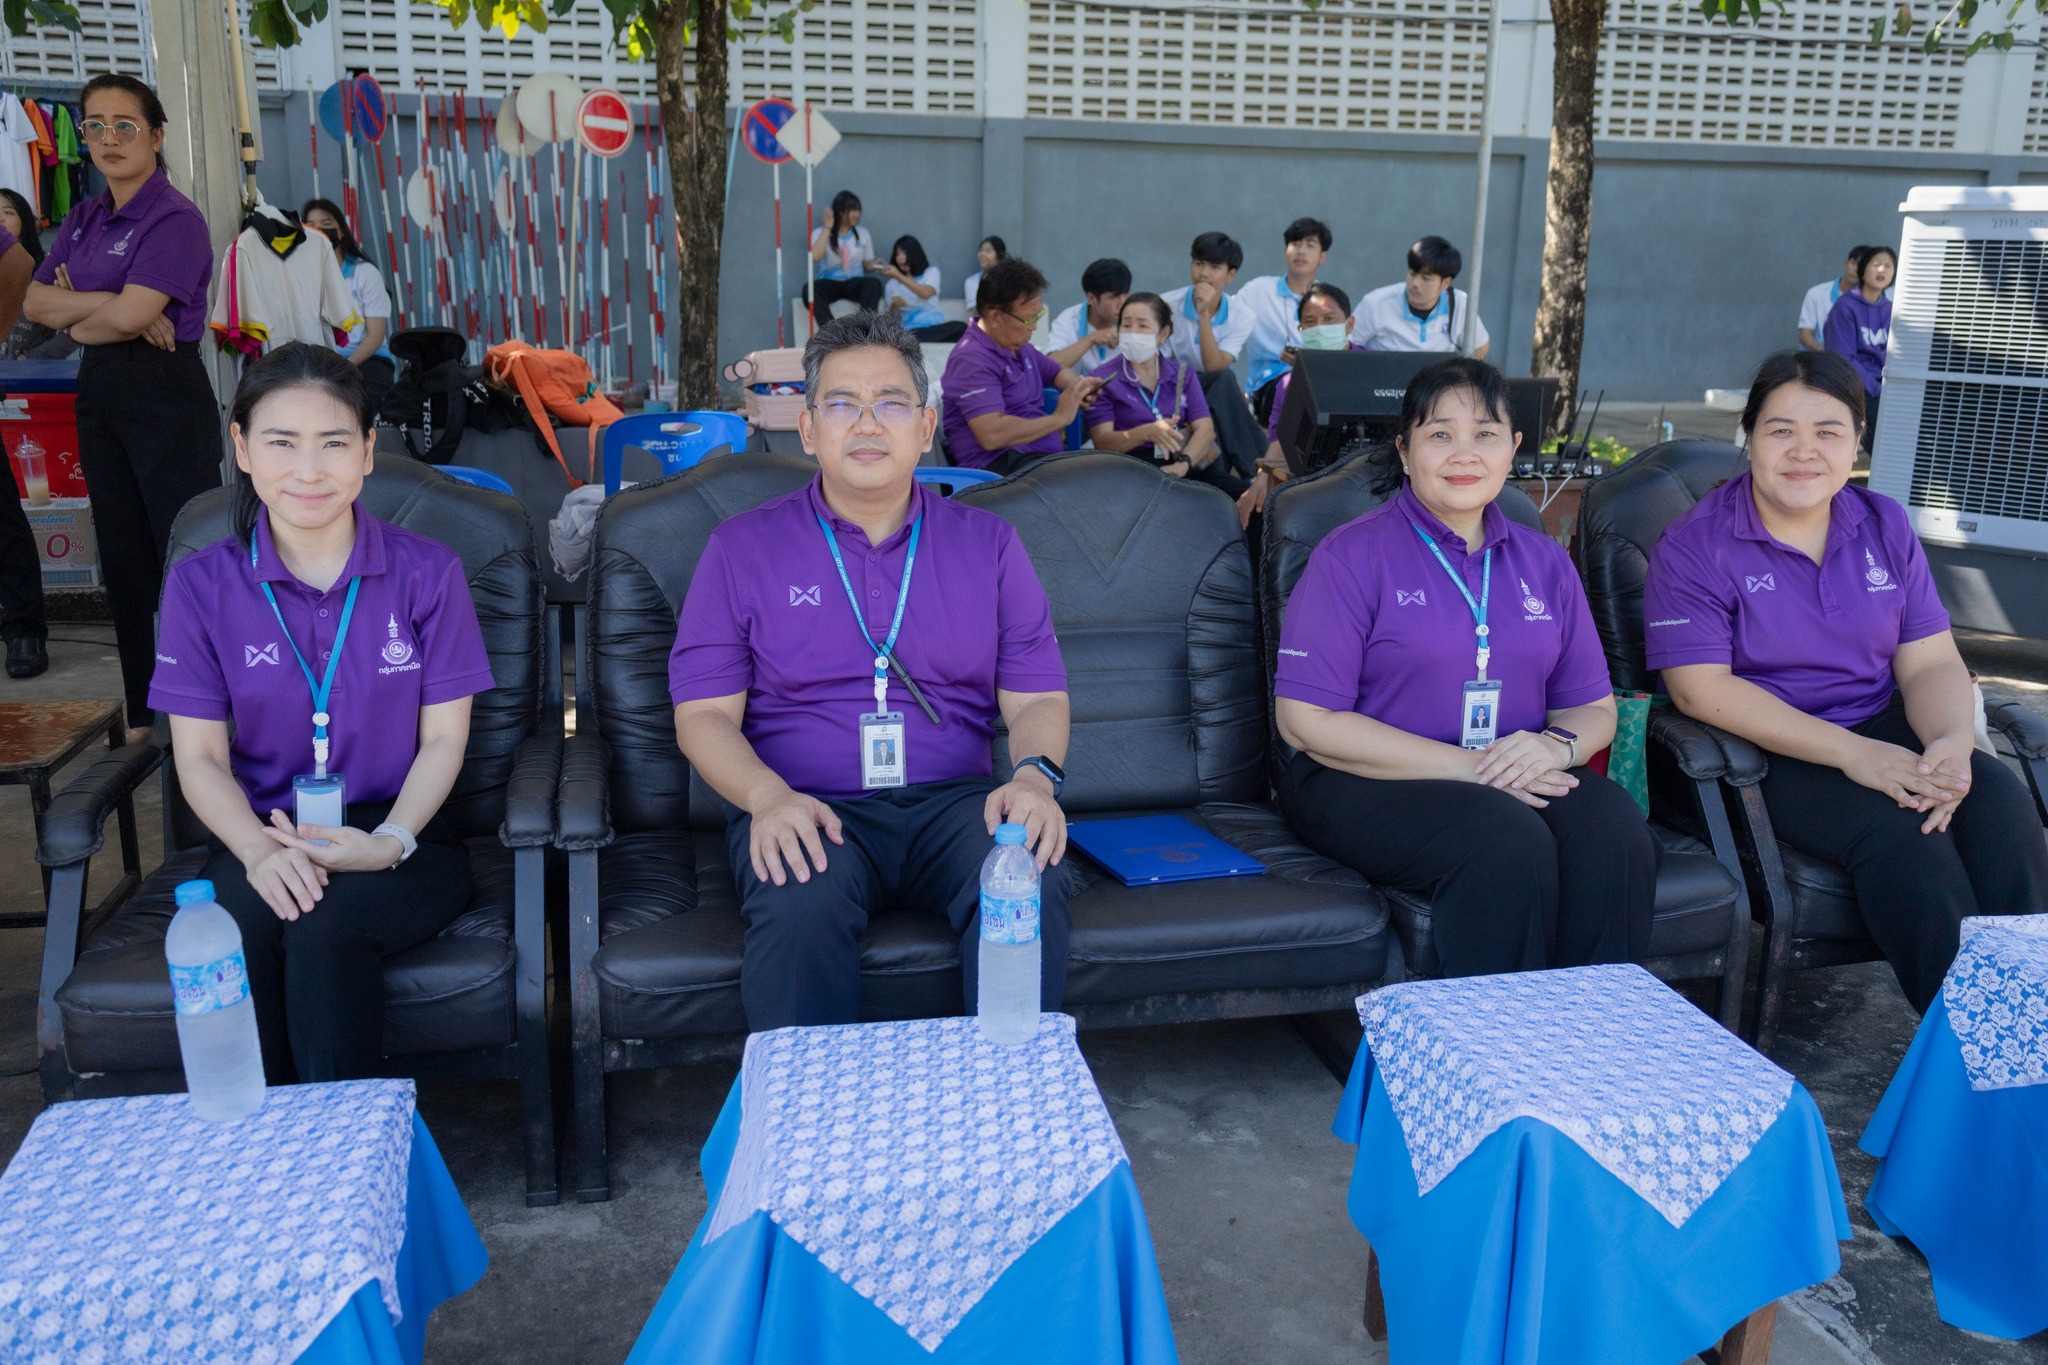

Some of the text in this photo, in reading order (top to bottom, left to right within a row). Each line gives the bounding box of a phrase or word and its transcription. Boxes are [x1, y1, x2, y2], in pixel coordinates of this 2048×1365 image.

[378, 661, 421, 676] กลุ่มภาคเหนือ
